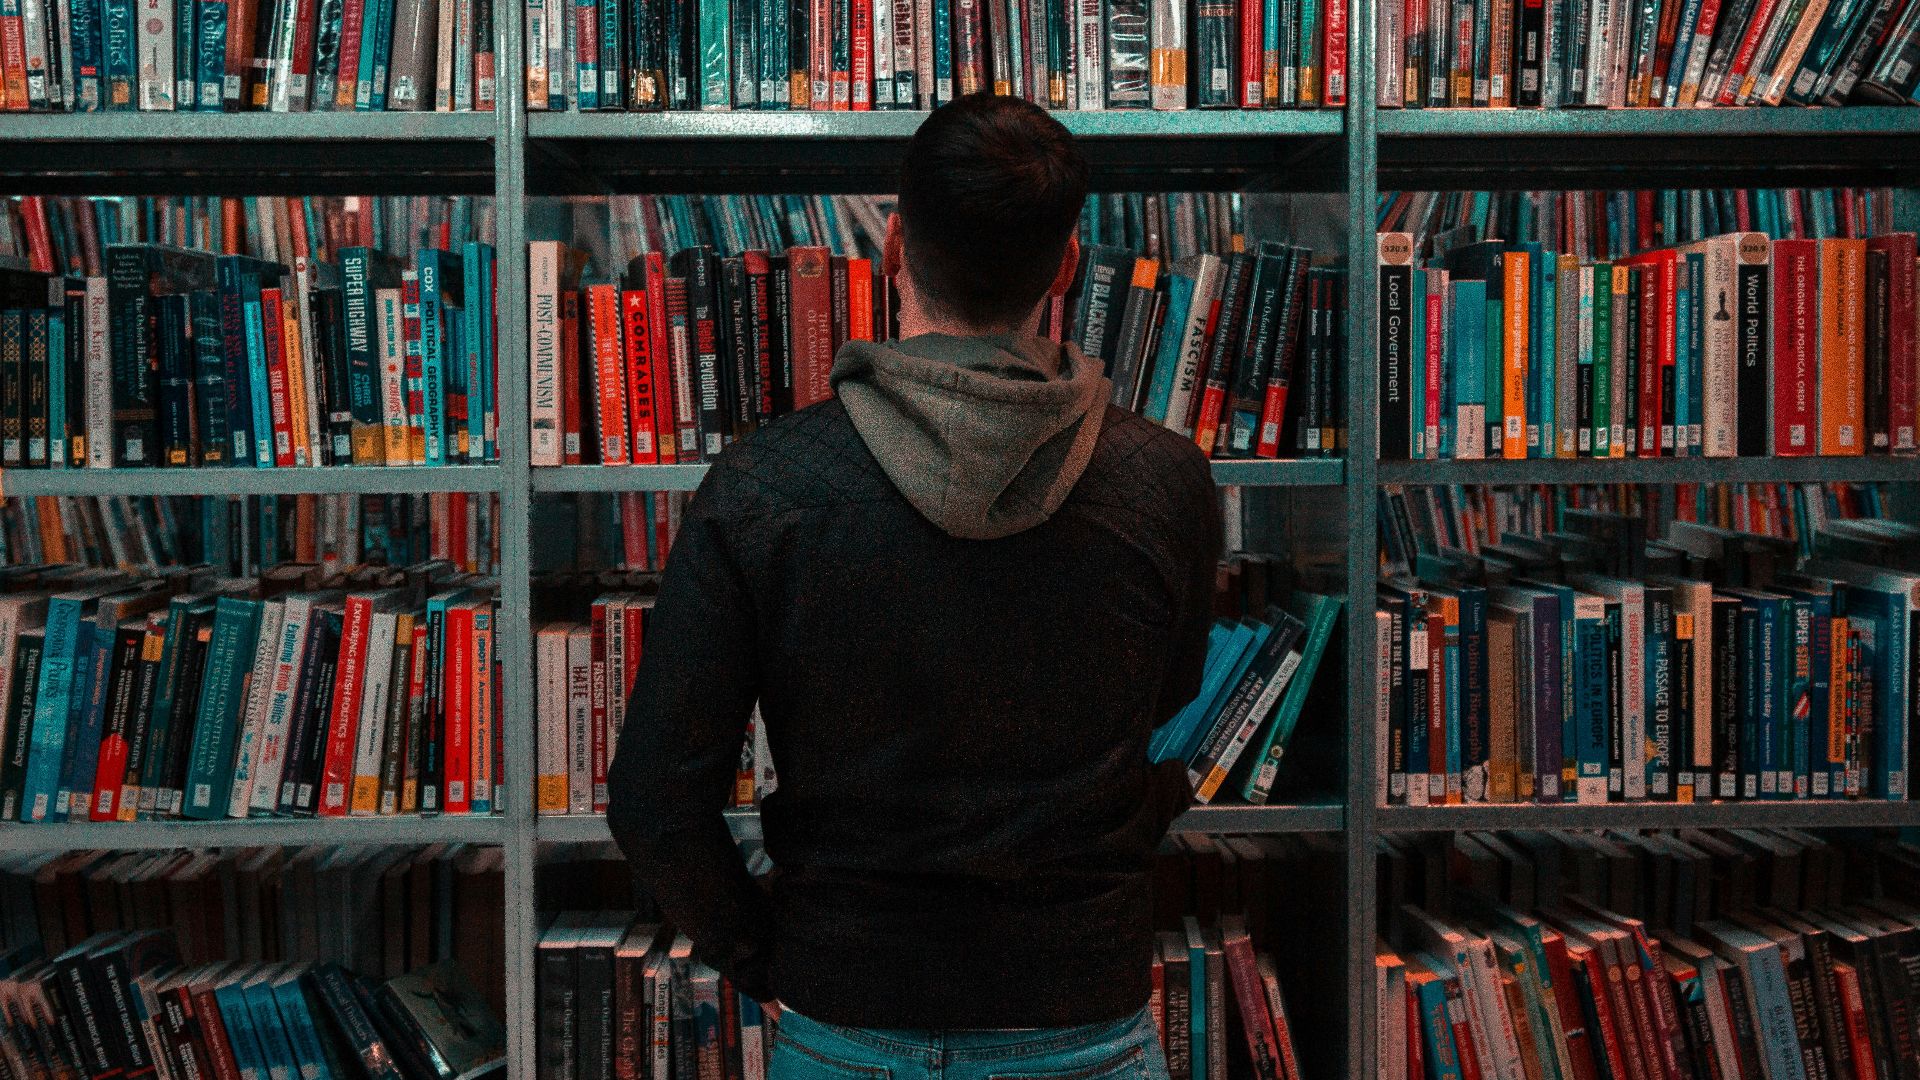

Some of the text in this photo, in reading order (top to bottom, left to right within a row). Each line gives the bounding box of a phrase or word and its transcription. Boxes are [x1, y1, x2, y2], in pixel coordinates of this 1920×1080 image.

[110, 6, 126, 66] Politics
[204, 8, 221, 69] Politics
[345, 257, 368, 352] SUPER HIGHWAY
[424, 266, 434, 293] COX
[697, 258, 706, 287] PONS
[1666, 259, 1674, 288] SCOTTISH
[1691, 260, 1699, 296] Devolution
[90, 296, 103, 360] Ross King
[135, 295, 147, 401] The Oxford Handbook of
[697, 320, 716, 353] Global
[756, 276, 772, 413] UNDER THE RED FLAG
[818, 312, 826, 331] THE
[819, 337, 828, 360] RISE
[1249, 287, 1274, 391] The Oxford Handbook of
[1388, 275, 1401, 403] Local Government
[1429, 300, 1438, 389] COMPARING LOCAL GOVERNANCE
[1599, 309, 1607, 317] OF
[1599, 320, 1607, 342] BRITISH
[1665, 314, 1673, 360] GOVERNMENT
[1690, 306, 1698, 328] Britain
[1690, 329, 1698, 349] today
[1746, 274, 1759, 367] World Politics
[1796, 255, 1805, 411] THE ORIGINS OF POLITICAL ORDER
[425, 300, 438, 439] POLITICAL GEOGRAPHY
[537, 294, 553, 409] POST-COMMUNISM
[632, 311, 650, 418] COMRADES
[700, 354, 721, 411] Revolution
[733, 298, 750, 422] The End of Communist Power
[807, 309, 819, 399] OF COMMUNISM
[821, 374, 830, 398] FALL
[1179, 316, 1206, 393] FASCISM
[353, 373, 362, 408] PARRY
[362, 374, 370, 406] CHRIS
[245, 638, 267, 728] CONSERVATISM
[269, 623, 300, 725] Exploring British Politics
[337, 602, 362, 737] EXPLORING BRITISH POLITICS
[572, 666, 588, 699] HATE
[593, 661, 604, 709] FASCISM
[1392, 613, 1402, 686] AFTER THE FALL
[1763, 622, 1771, 718] European politics today
[1891, 605, 1900, 694] ARAB NATIONALISM
[12, 647, 39, 767] Patterns of Democracy
[120, 669, 132, 711] GOVERNMENT
[130, 663, 153, 769] COMPARING ASIAN POLITICS
[196, 623, 226, 774] IN THE TWENTIETH CENTURY
[205, 624, 238, 776] THE BRITISH CONSTITUTION
[1199, 670, 1257, 755] IN THE TWENTIETH CENTURY
[1208, 677, 1264, 761] ARAB NATIONALISM
[1420, 711, 1425, 720] IN
[1590, 625, 1603, 752] POLITICS IN EUROPE
[1654, 641, 1669, 765] THE PASSAGE TO EUROPE
[576, 707, 585, 772] MATTHEW COLLINS
[1820, 943, 1837, 995] WINSTON
[69, 967, 109, 1069] THE POPULIST RADICAL RIGHT
[104, 964, 144, 1065] THE POPULIST RADICAL RIGHT
[656, 983, 668, 1059] Orange Parades
[1178, 993, 1191, 1069] THE POLITICS
[1789, 979, 1810, 1039] BRITAIN
